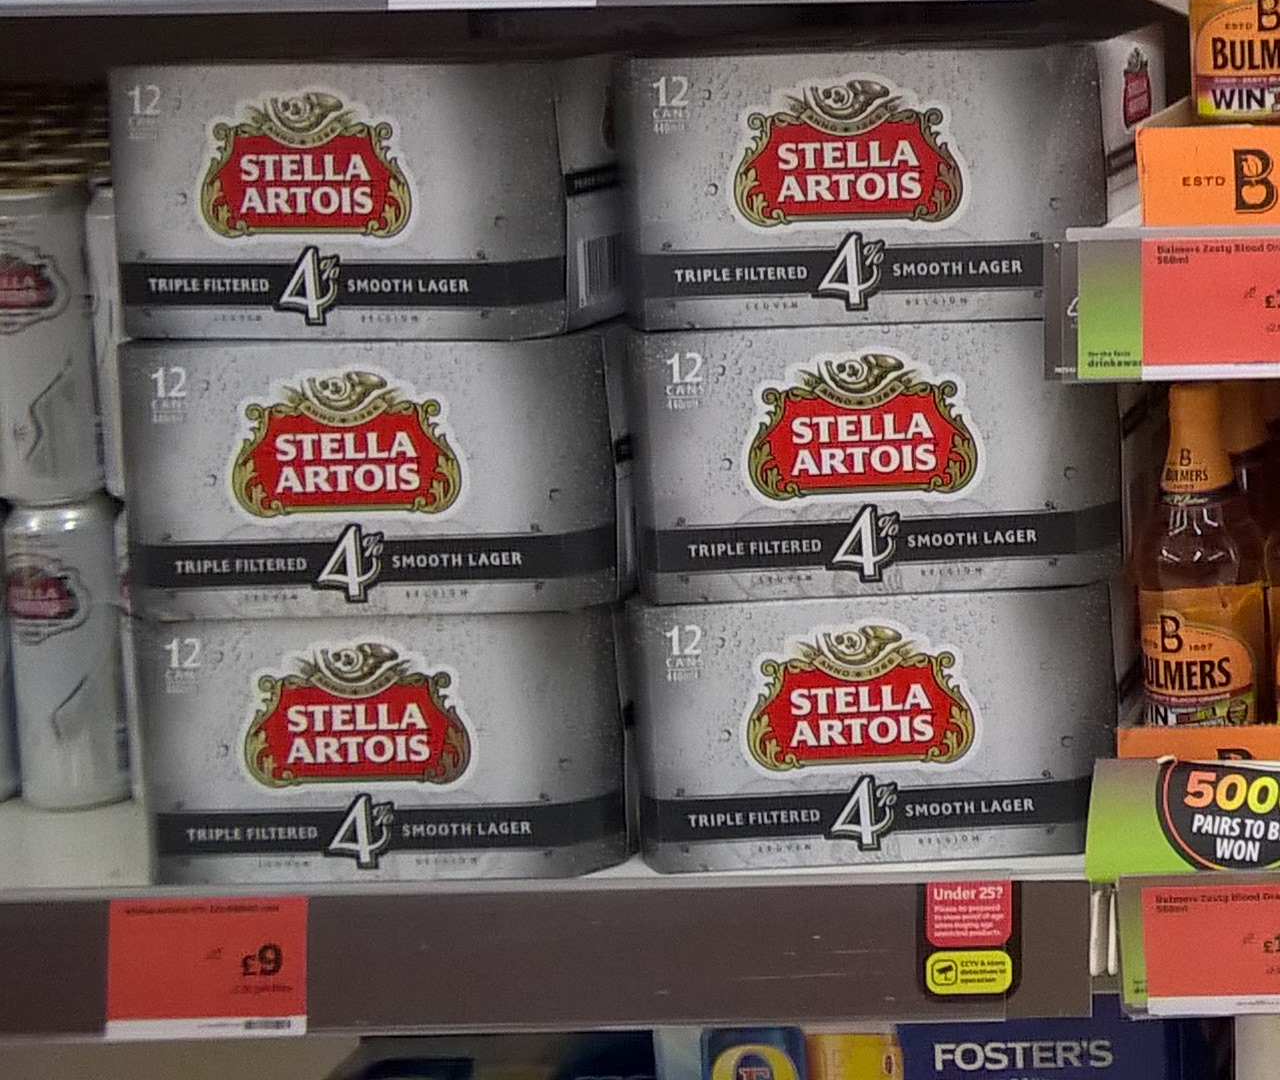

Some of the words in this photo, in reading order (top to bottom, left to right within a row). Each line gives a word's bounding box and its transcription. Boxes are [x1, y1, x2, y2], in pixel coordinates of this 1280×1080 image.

[127, 85, 161, 116] 12
[652, 76, 689, 108] 12
[1212, 88, 1266, 110] WIN
[240, 153, 370, 182] STELLA
[777, 138, 919, 170] STELLA
[777, 171, 922, 202] ARTOIS
[1181, 175, 1226, 186] ESTD
[240, 186, 373, 215] ARTOIS
[1203, 244, 1231, 254] Zesty
[674, 268, 729, 283] TRIPLE
[736, 265, 808, 281] FILTERED
[893, 261, 963, 277] SMOOTH
[968, 258, 1023, 275] LAGER
[790, 684, 933, 715] STELLA
[286, 703, 428, 732] STELLA
[790, 715, 935, 747] ARTOIS
[287, 735, 431, 764] ARTOIS
[1192, 814, 1240, 837] PAIRS
[1245, 818, 1266, 839] TO
[1216, 837, 1260, 862] WON
[934, 887, 976, 901] Under
[979, 887, 1004, 900] 25?
[241, 943, 283, 977] £9
[934, 1040, 1114, 1071] FOSTER'S
